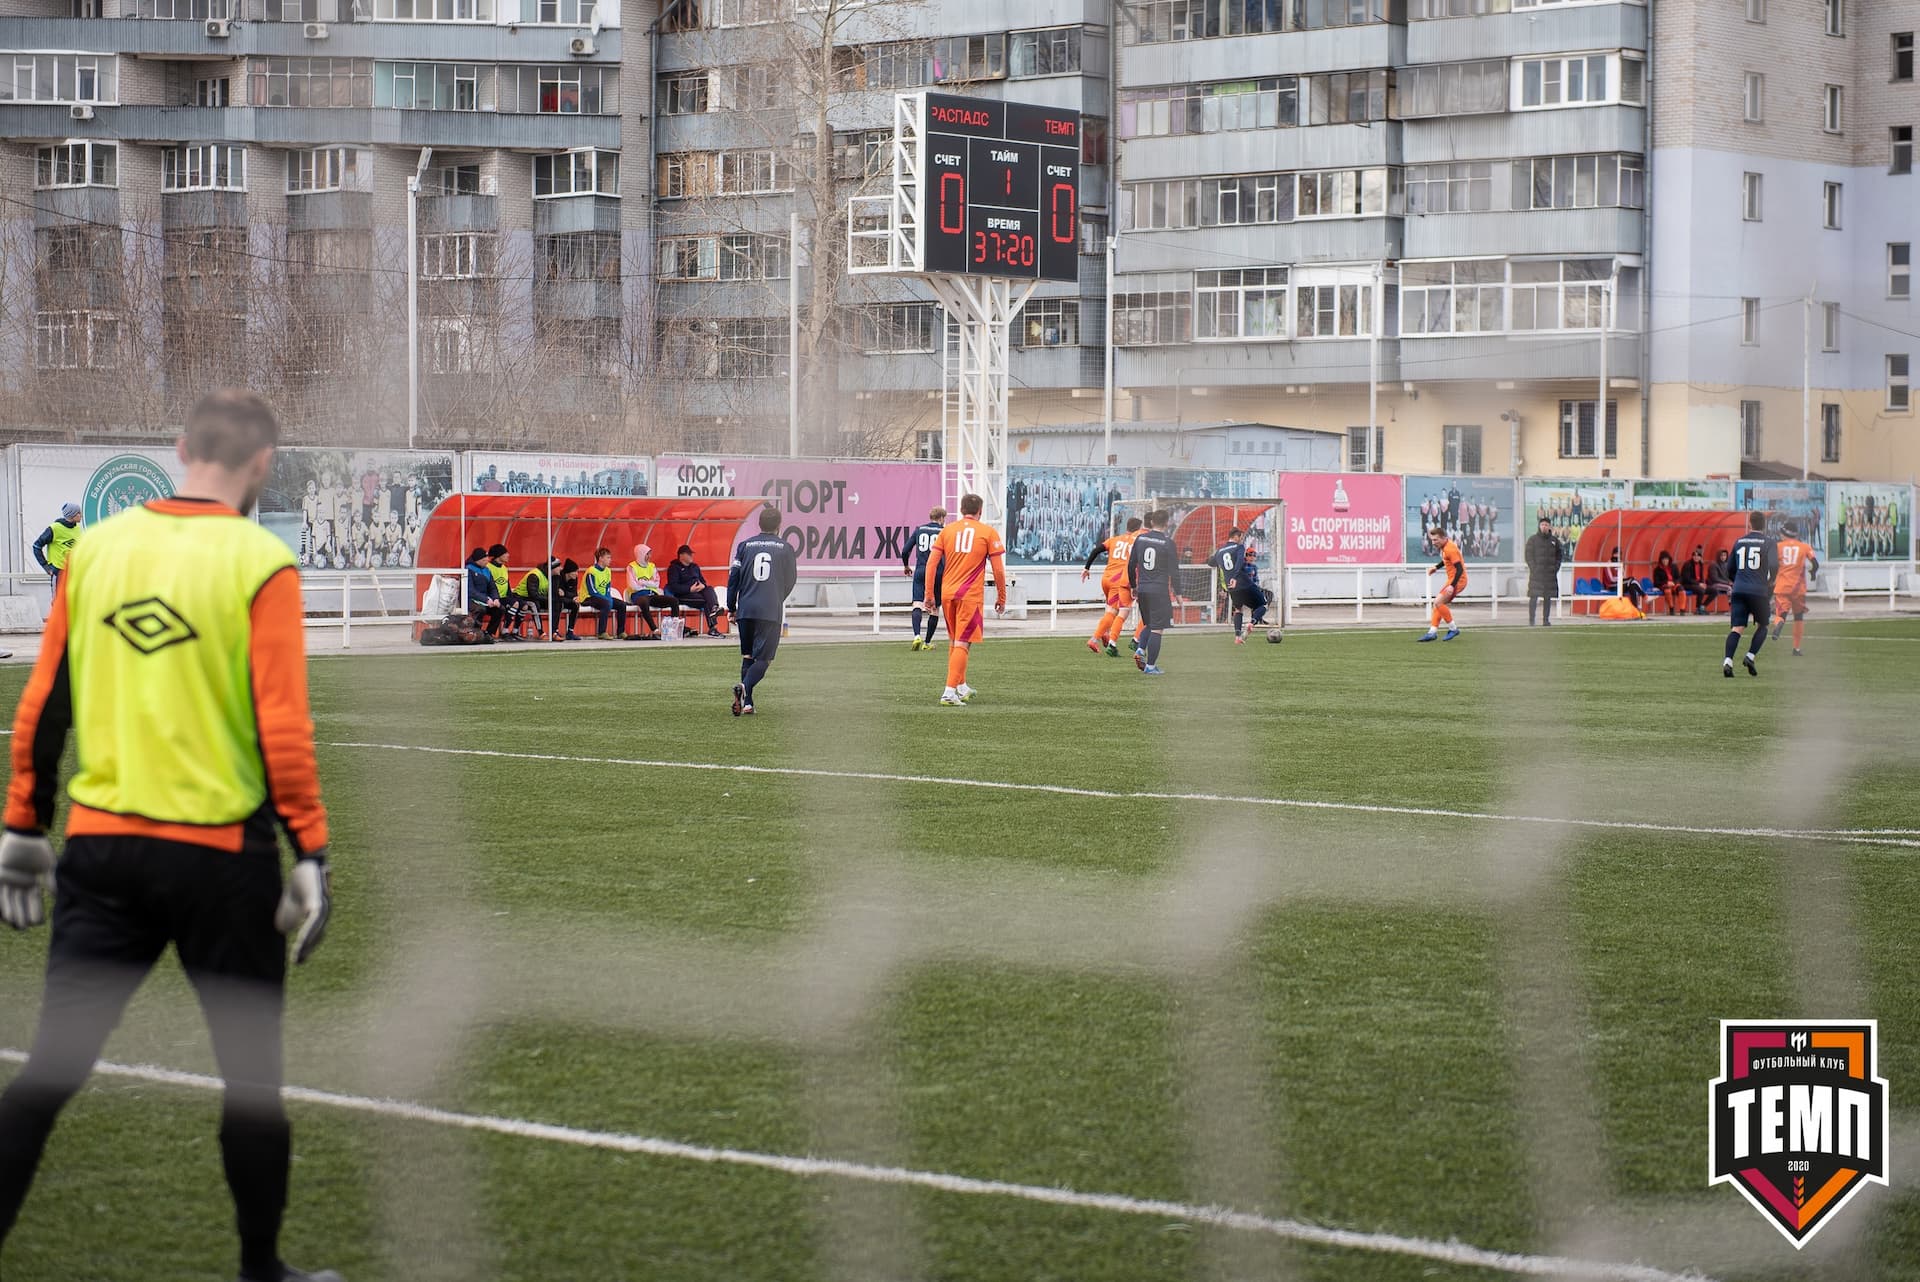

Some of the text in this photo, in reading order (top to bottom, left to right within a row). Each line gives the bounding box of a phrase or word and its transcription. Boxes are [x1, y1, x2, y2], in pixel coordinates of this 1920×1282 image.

[1044, 119, 1075, 136] ТЕМП
[934, 153, 962, 166] СЧЕТ
[990, 150, 1019, 163] ТАЙМ
[1006, 168, 1012, 195] 1
[1046, 165, 1073, 178] СЧЕТ
[939, 172, 965, 235] 0
[1051, 183, 1076, 244] 0
[987, 217, 1021, 231] ВРЕМЯ
[974, 230, 1035, 267] 37:20
[677, 464, 725, 484] СПОРТ
[761, 479, 847, 513] СПОРТ
[1290, 515, 1391, 533] ЗА СПОРТИВНЫЙ
[781, 525, 866, 560] ОРМА
[954, 527, 975, 553] 10
[1297, 534, 1385, 550] ОБРАЗ ЖИЗНИ!
[753, 551, 772, 582] 6
[1143, 546, 1157, 571] 9
[1222, 552, 1234, 571] 8
[1736, 546, 1761, 570] 15
[1782, 545, 1800, 566] 97
